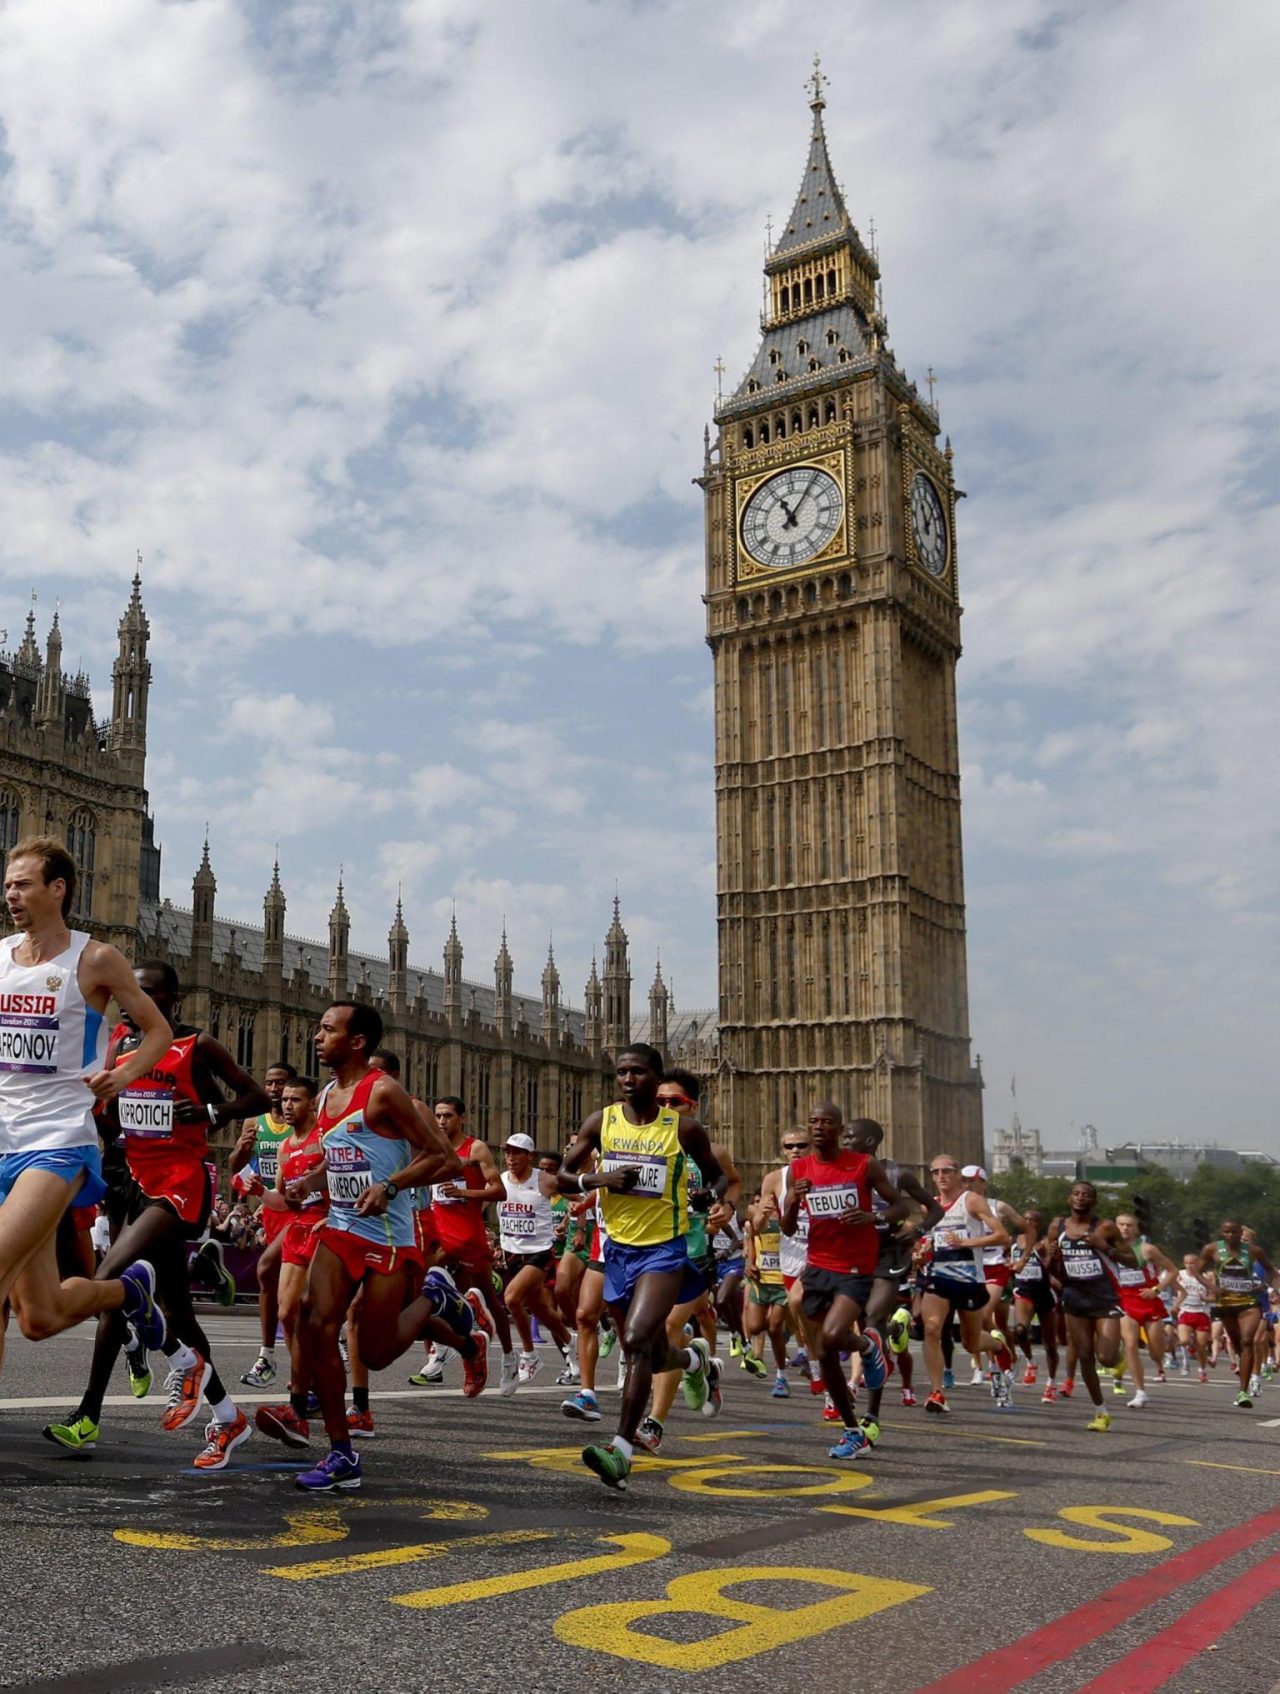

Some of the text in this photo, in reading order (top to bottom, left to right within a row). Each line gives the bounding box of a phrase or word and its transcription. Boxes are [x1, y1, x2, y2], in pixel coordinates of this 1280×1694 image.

[1, 1017, 40, 1027] London 2012
[120, 1104, 171, 1127] KIPROTICH
[613, 1138, 665, 1151] RWANDA
[615, 1153, 652, 1163] London 2012
[502, 1203, 533, 1213] PERU
[808, 1192, 857, 1212] TEBULO
[501, 1219, 535, 1233] PACHECO
[1066, 1262, 1101, 1275] MUSSA
